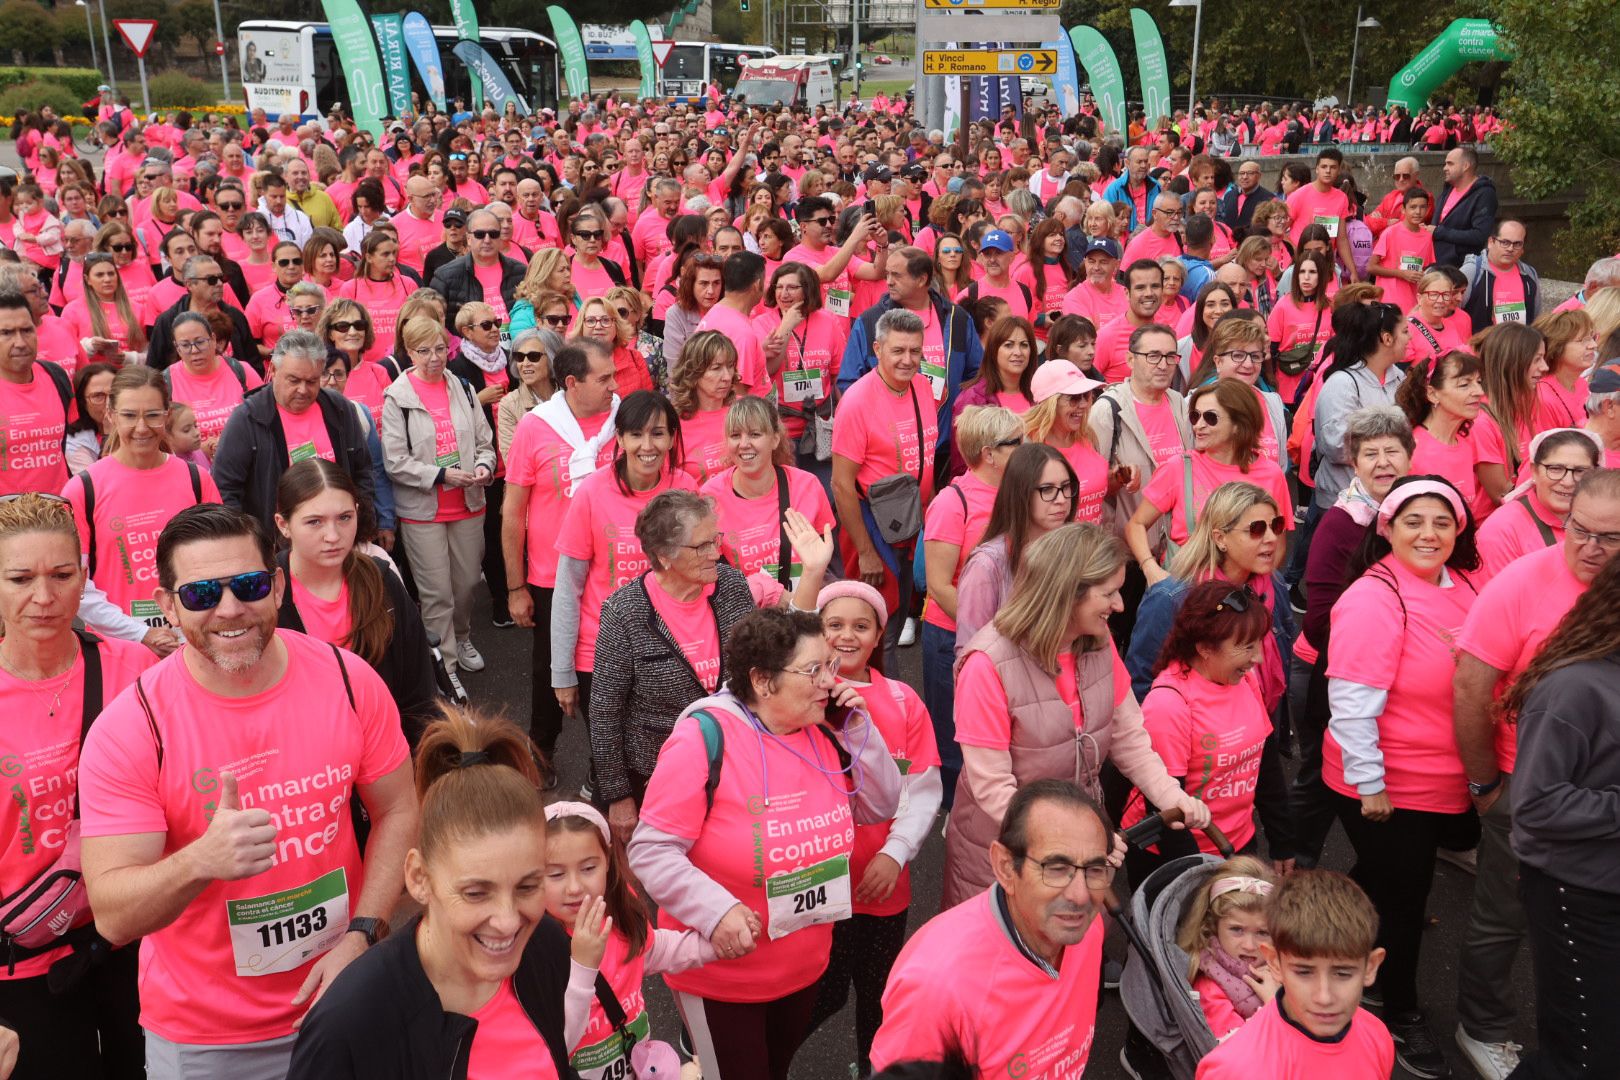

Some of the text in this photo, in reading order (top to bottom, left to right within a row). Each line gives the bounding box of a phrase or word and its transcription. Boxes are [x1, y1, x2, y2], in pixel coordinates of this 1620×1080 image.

[1458, 37, 1484, 46] contra
[1353, 240, 1371, 249] VANS
[1502, 312, 1520, 320] 8703
[10, 428, 27, 440] En
[127, 530, 149, 545] En
[617, 542, 636, 554] En
[741, 544, 759, 558] En
[617, 559, 648, 571] con
[1217, 753, 1237, 767] En
[28, 774, 62, 798] En
[241, 764, 352, 810] n marcha
[1206, 776, 1258, 800] cánc
[270, 785, 348, 831] ntra el
[11, 784, 36, 856] SALAMANCA
[766, 803, 852, 838] En marcha
[752, 822, 765, 888] SALAMANCA
[768, 834, 844, 863] contra
[236, 900, 276, 911] Salamanca
[287, 888, 312, 900] marcha
[236, 908, 260, 916] contra
[270, 902, 294, 912] cáncer
[794, 886, 828, 914] 204
[48, 910, 72, 931] NIKE
[256, 906, 328, 948] 11133
[588, 1018, 600, 1034] n
